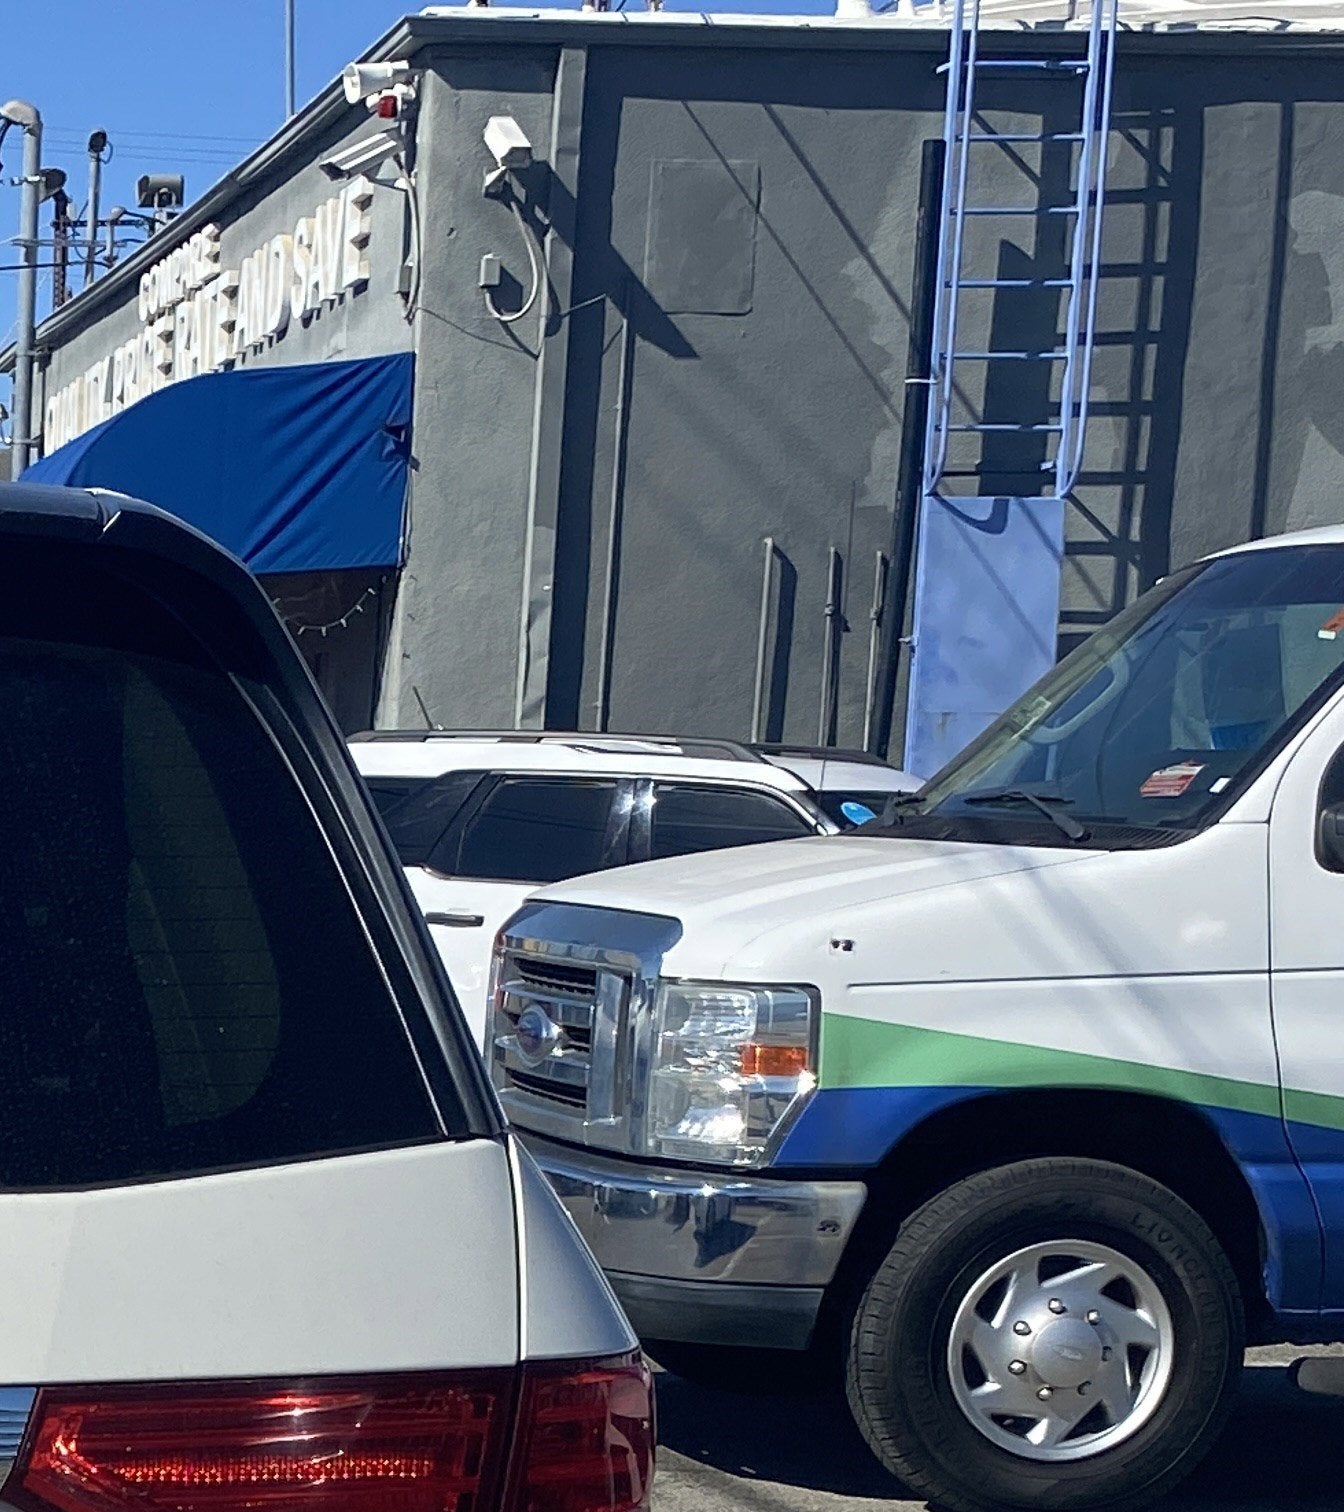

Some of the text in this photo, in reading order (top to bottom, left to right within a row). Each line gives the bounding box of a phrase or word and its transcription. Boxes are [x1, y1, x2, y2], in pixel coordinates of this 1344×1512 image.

[139, 223, 220, 322] COMPARE
[174, 270, 240, 381] RATE
[235, 234, 292, 353] AND
[290, 174, 374, 320] SAVE
